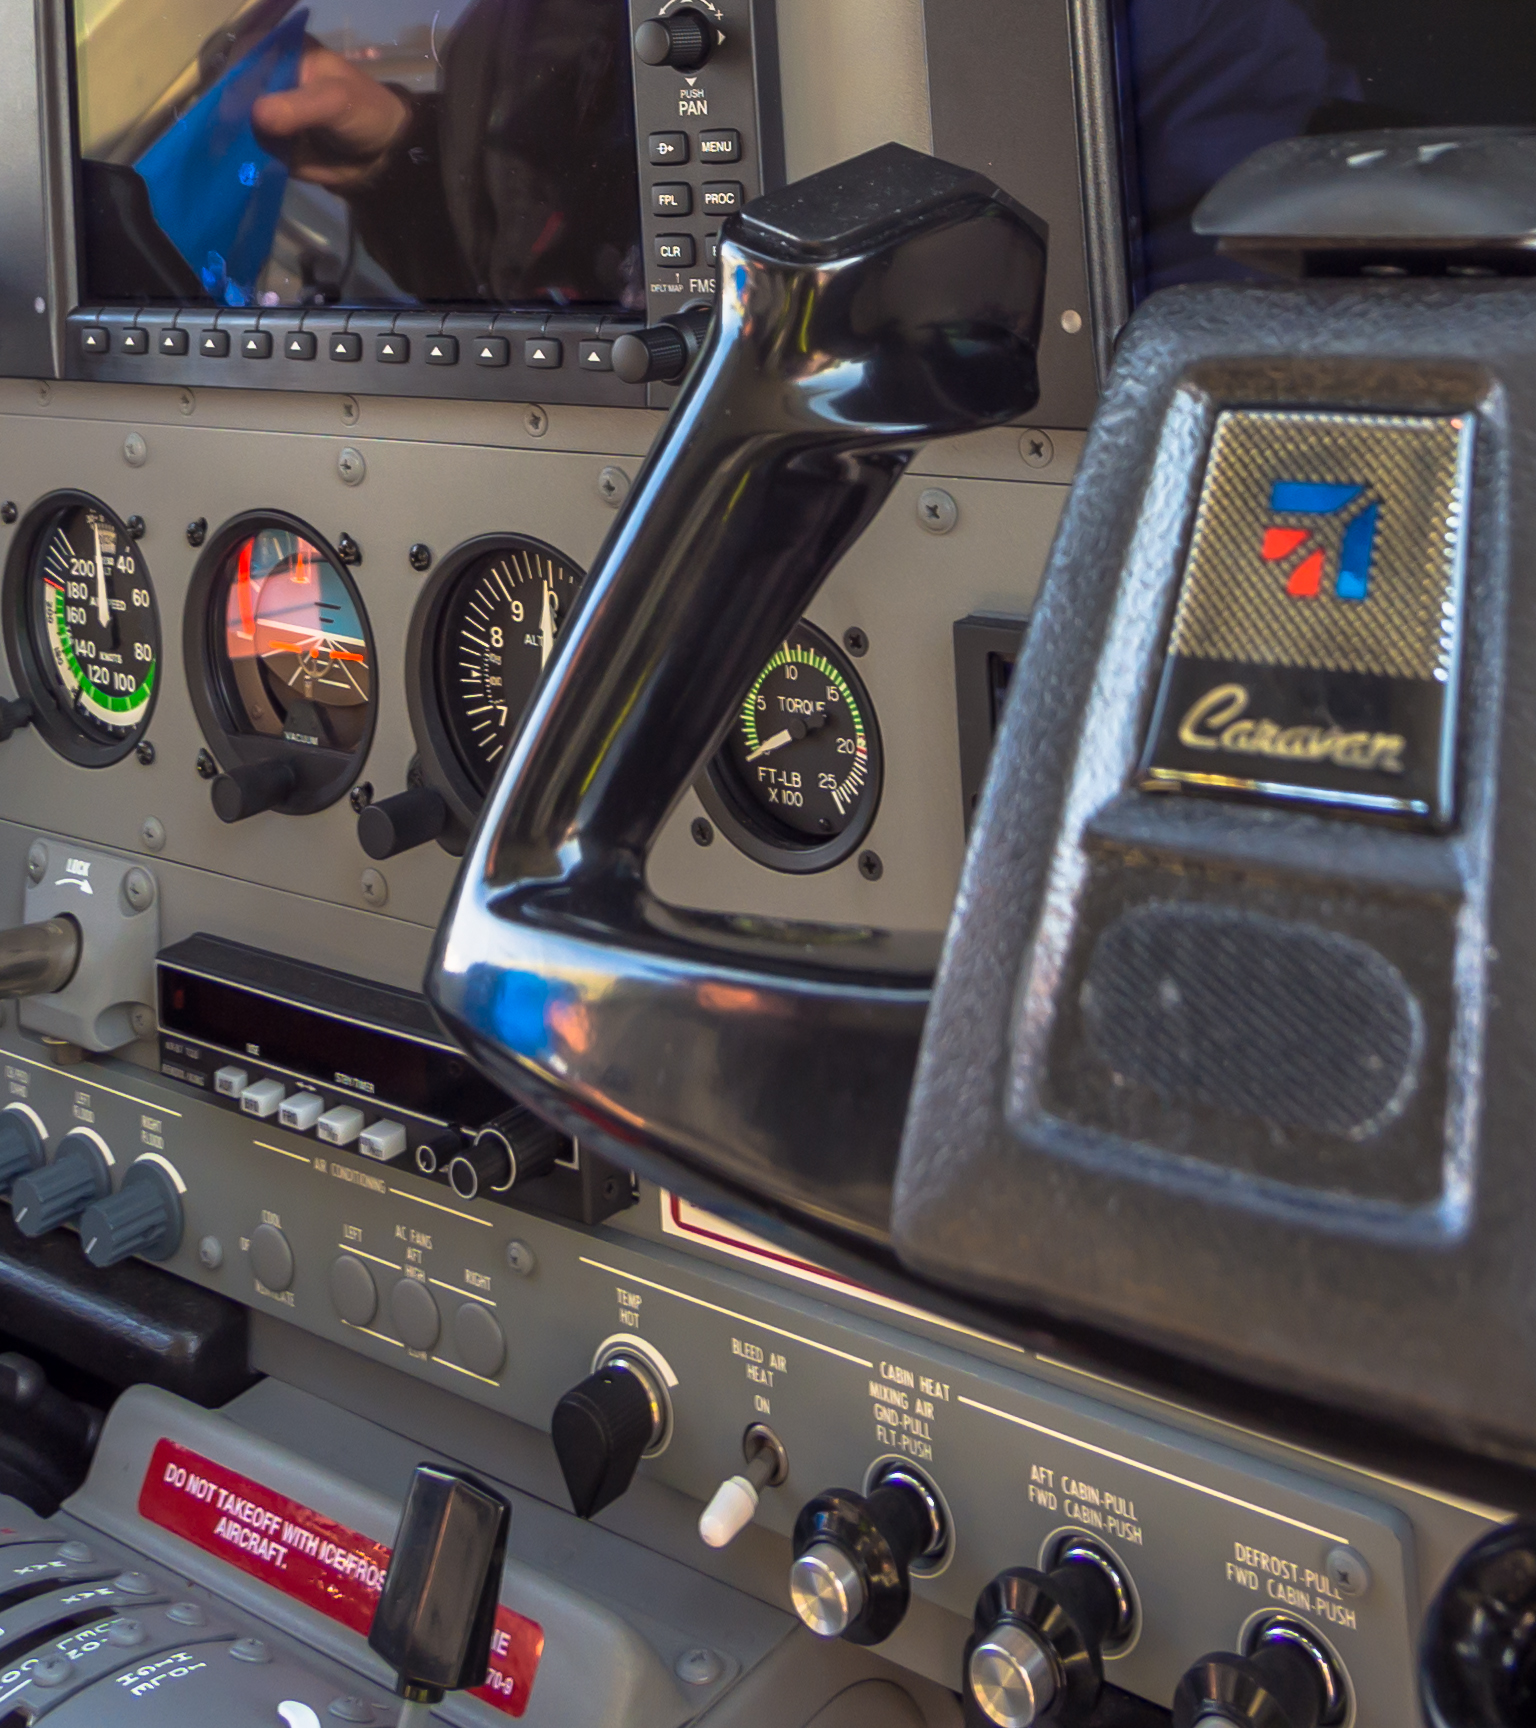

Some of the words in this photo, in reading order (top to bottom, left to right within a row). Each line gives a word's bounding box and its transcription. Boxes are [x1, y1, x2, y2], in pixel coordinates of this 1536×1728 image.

[680, 89, 705, 100] PUSH
[678, 100, 709, 117] PAN
[701, 140, 732, 154] MENU
[659, 195, 678, 207] FPL
[705, 193, 735, 205] PROC
[660, 246, 681, 258] CLR
[70, 559, 94, 578] 200
[117, 555, 135, 575] 40
[66, 581, 88, 600] 180
[132, 588, 150, 608] 60
[66, 606, 87, 625] 160
[511, 600, 525, 623] 9
[74, 638, 97, 659] 140
[490, 626, 504, 649] 8
[134, 641, 153, 662] 80
[87, 664, 111, 686] 120
[113, 672, 136, 693] 100
[784, 664, 799, 681] 10
[757, 695, 767, 711] 5
[825, 685, 841, 703] 15
[495, 705, 509, 727] 7
[777, 695, 827, 716] TORQUE
[1178, 683, 1407, 774] Caravan
[836, 737, 856, 755] 20
[757, 766, 802, 789] FT-LB
[817, 772, 838, 790] 25
[768, 788, 779, 804] X
[781, 789, 804, 807] 100
[616, 1286, 643, 1310] TEMP
[619, 1308, 641, 1330] HOT
[731, 1337, 764, 1366] BLEED
[768, 1351, 789, 1374] AIR
[745, 1363, 775, 1389] HEAT
[878, 1361, 915, 1390] CABIN
[919, 1374, 951, 1403] HEAT
[753, 1393, 772, 1415] ON
[868, 1380, 910, 1412] MIXING
[914, 1399, 935, 1422] AIR
[873, 1402, 934, 1442] GND-PULL
[875, 1424, 934, 1463] FLT-PUSH
[1029, 1463, 1056, 1492] AFT
[1061, 1473, 1140, 1523] CABIN-PULL
[1027, 1483, 1059, 1513] FWD
[1062, 1497, 1144, 1547] CABIN-PUSH
[164, 1461, 187, 1489] DO
[184, 1473, 219, 1505] NOT
[216, 1487, 284, 1536] TAKEOFF
[281, 1520, 322, 1558] WITH
[317, 1539, 388, 1593] ICE/FROS
[213, 1515, 290, 1571] AIRCRAFT.
[1224, 1561, 1260, 1592] FWD
[1266, 1577, 1358, 1631] CABIN-PUSH
[55, 1617, 125, 1651] UEL
[115, 1651, 194, 1687] HIGH
[130, 1661, 208, 1697] IDLE
